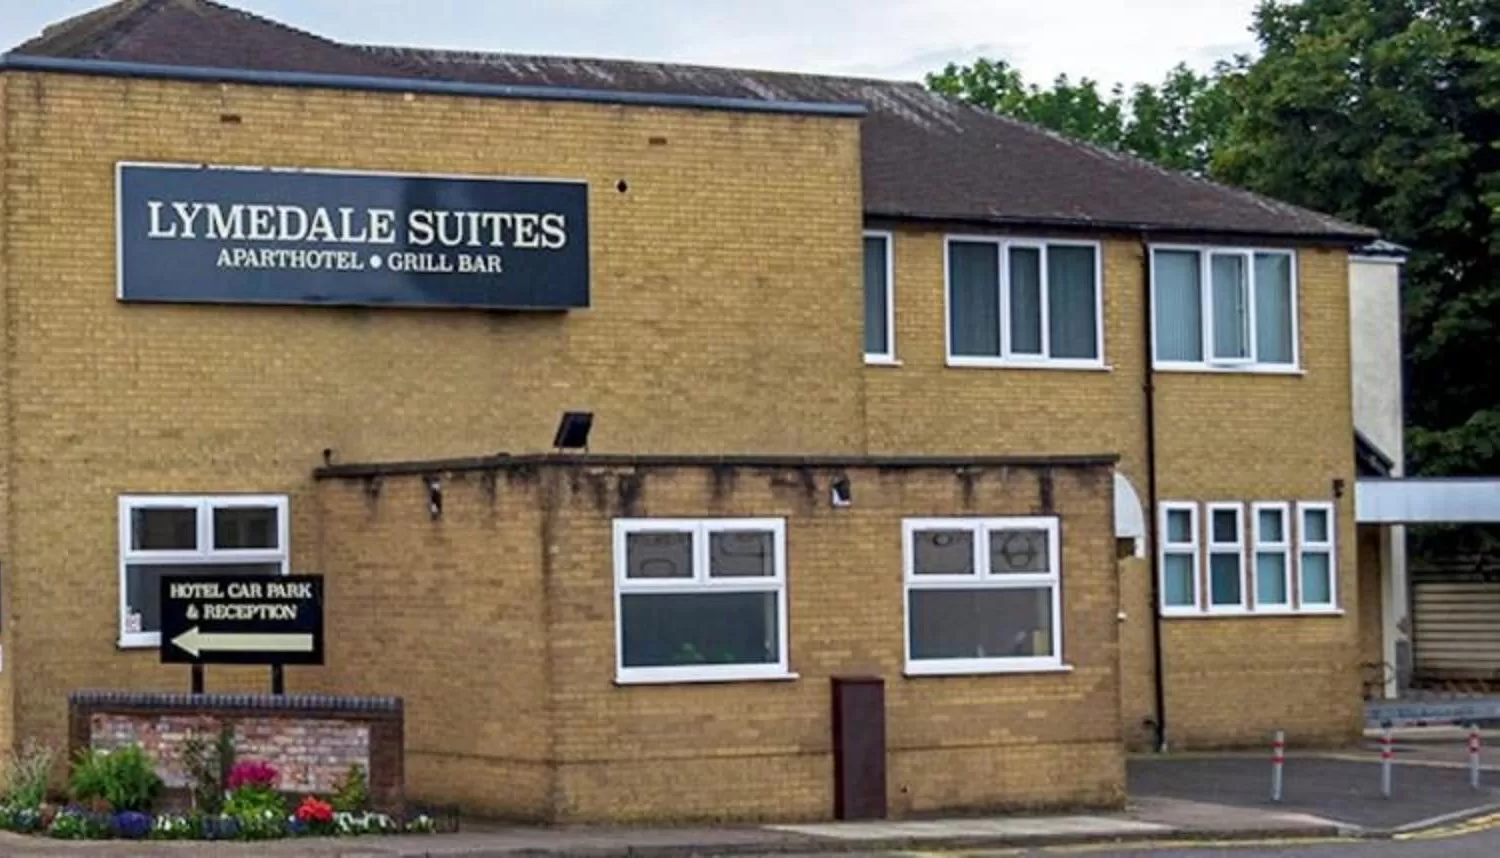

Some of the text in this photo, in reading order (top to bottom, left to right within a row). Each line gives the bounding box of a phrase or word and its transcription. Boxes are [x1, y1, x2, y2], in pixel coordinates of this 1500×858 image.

[148, 201, 567, 249] LYMEDALE SUITES
[216, 248, 503, 273] APARTHOTEL GRILL BAR
[170, 583, 313, 598] HOTEL CAR PARK
[185, 603, 298, 620] & RECEPTION
